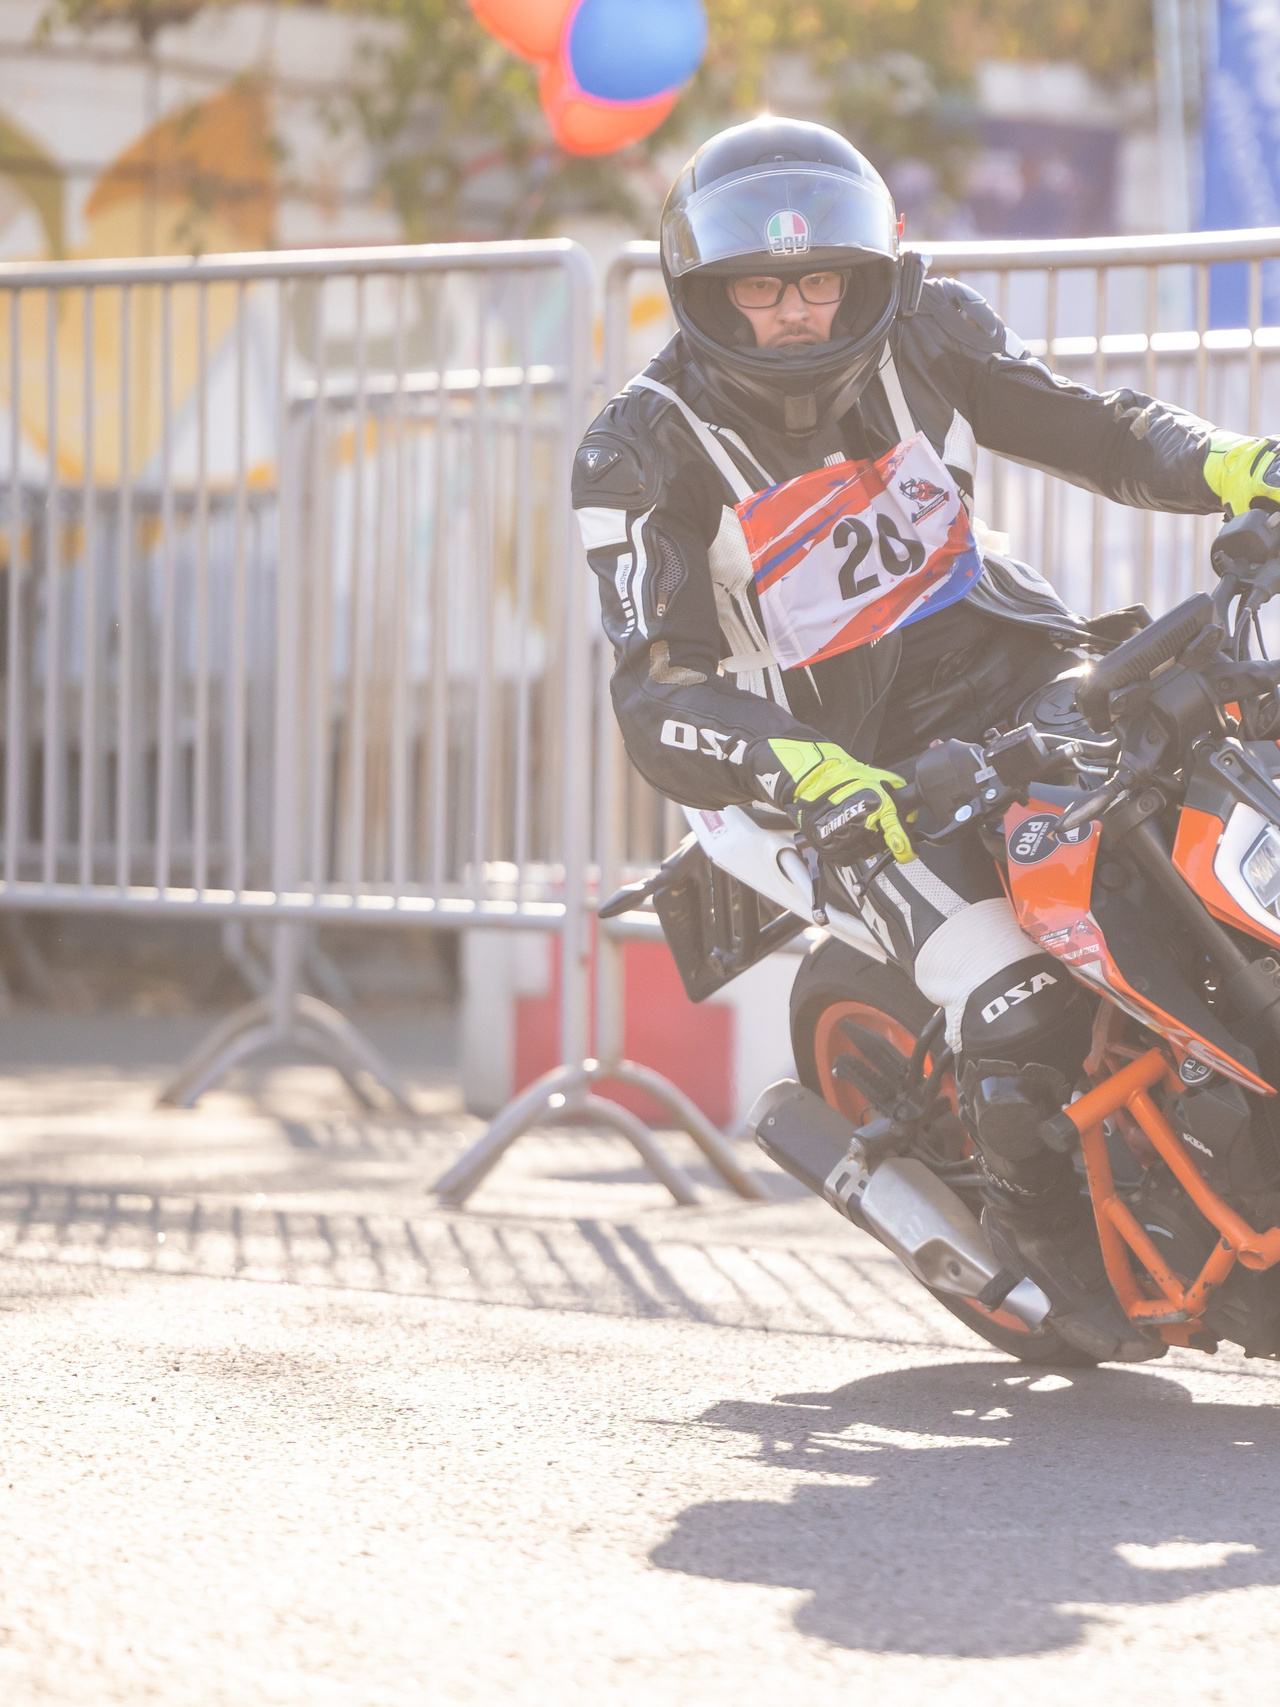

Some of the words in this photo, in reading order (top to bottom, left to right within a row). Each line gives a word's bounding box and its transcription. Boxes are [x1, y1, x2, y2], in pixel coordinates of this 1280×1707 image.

[619, 563, 630, 593] INVADER
[820, 800, 866, 839] DAINESE
[1015, 821, 1044, 856] PRO
[1183, 1132, 1214, 1158] KTM
